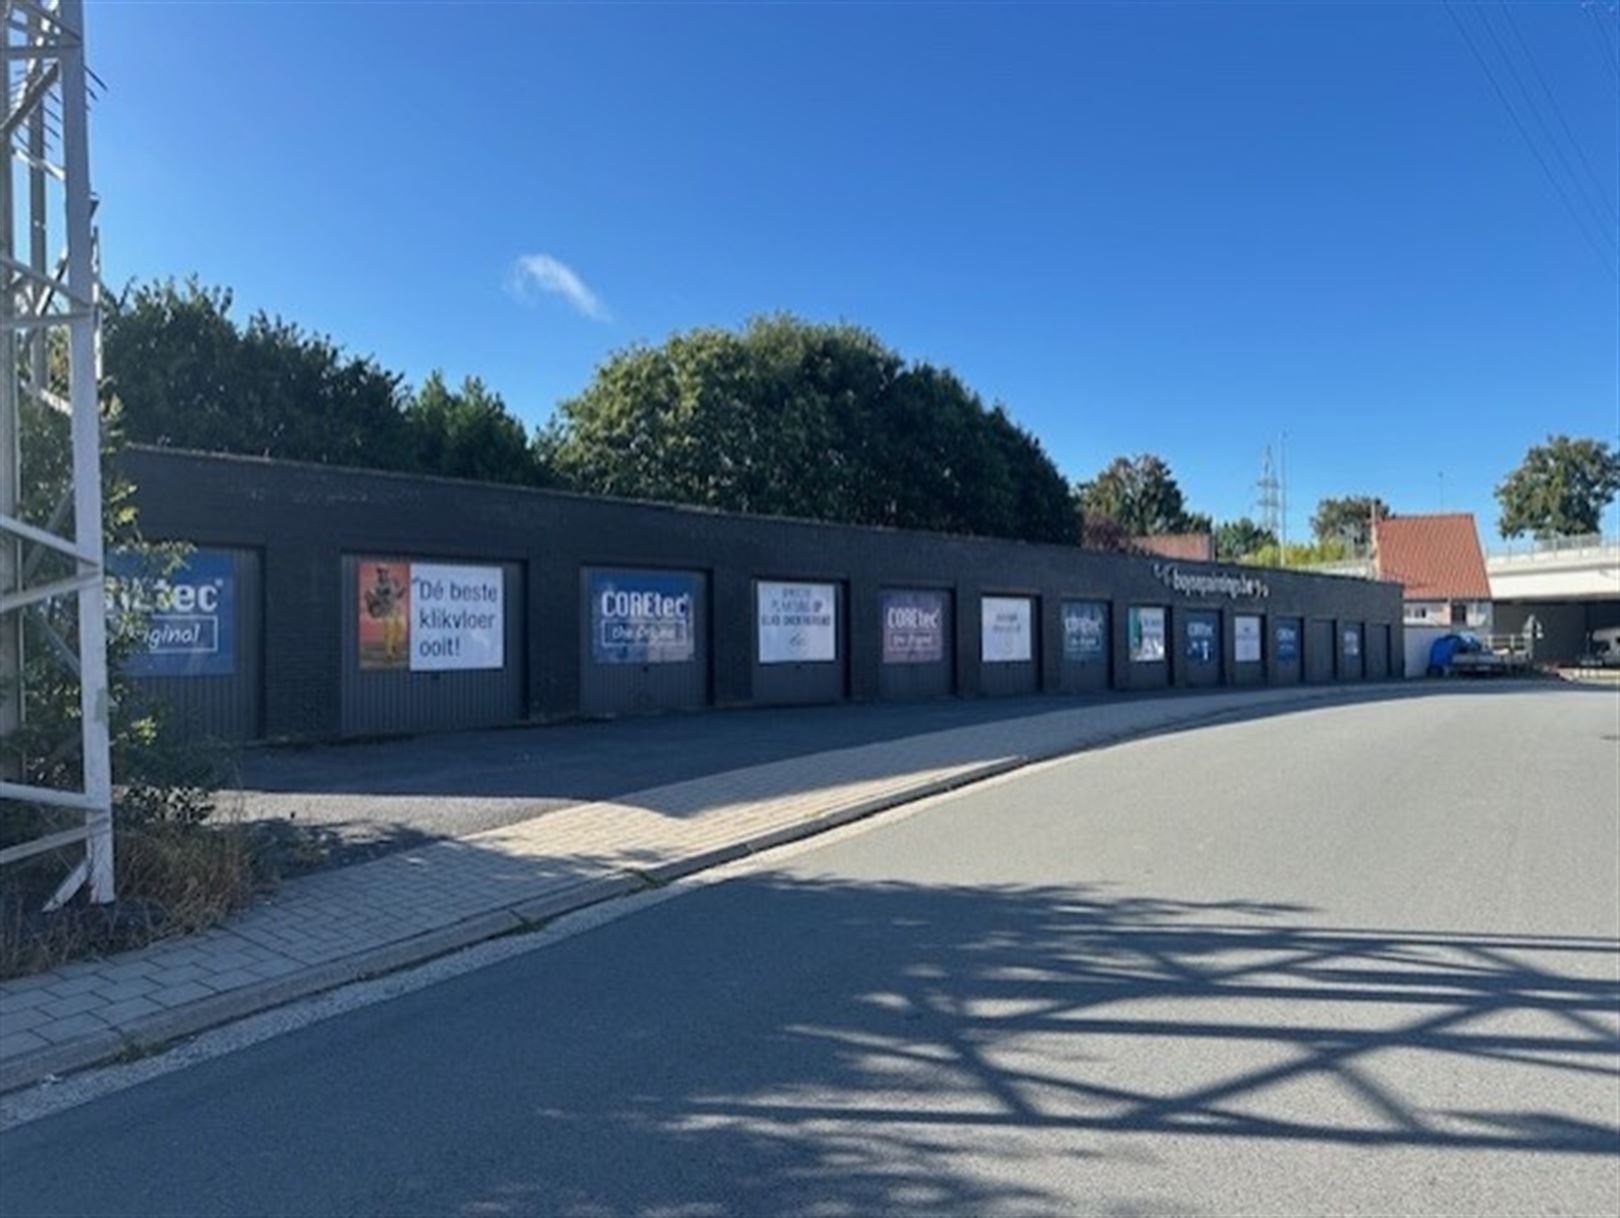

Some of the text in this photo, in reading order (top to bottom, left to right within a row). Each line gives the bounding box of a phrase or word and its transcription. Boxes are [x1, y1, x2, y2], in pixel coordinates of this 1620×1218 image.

[450, 582, 497, 602] beste
[601, 591, 687, 617] COREtec
[419, 607, 496, 629] klikvloer
[419, 635, 460, 657] ooit!
